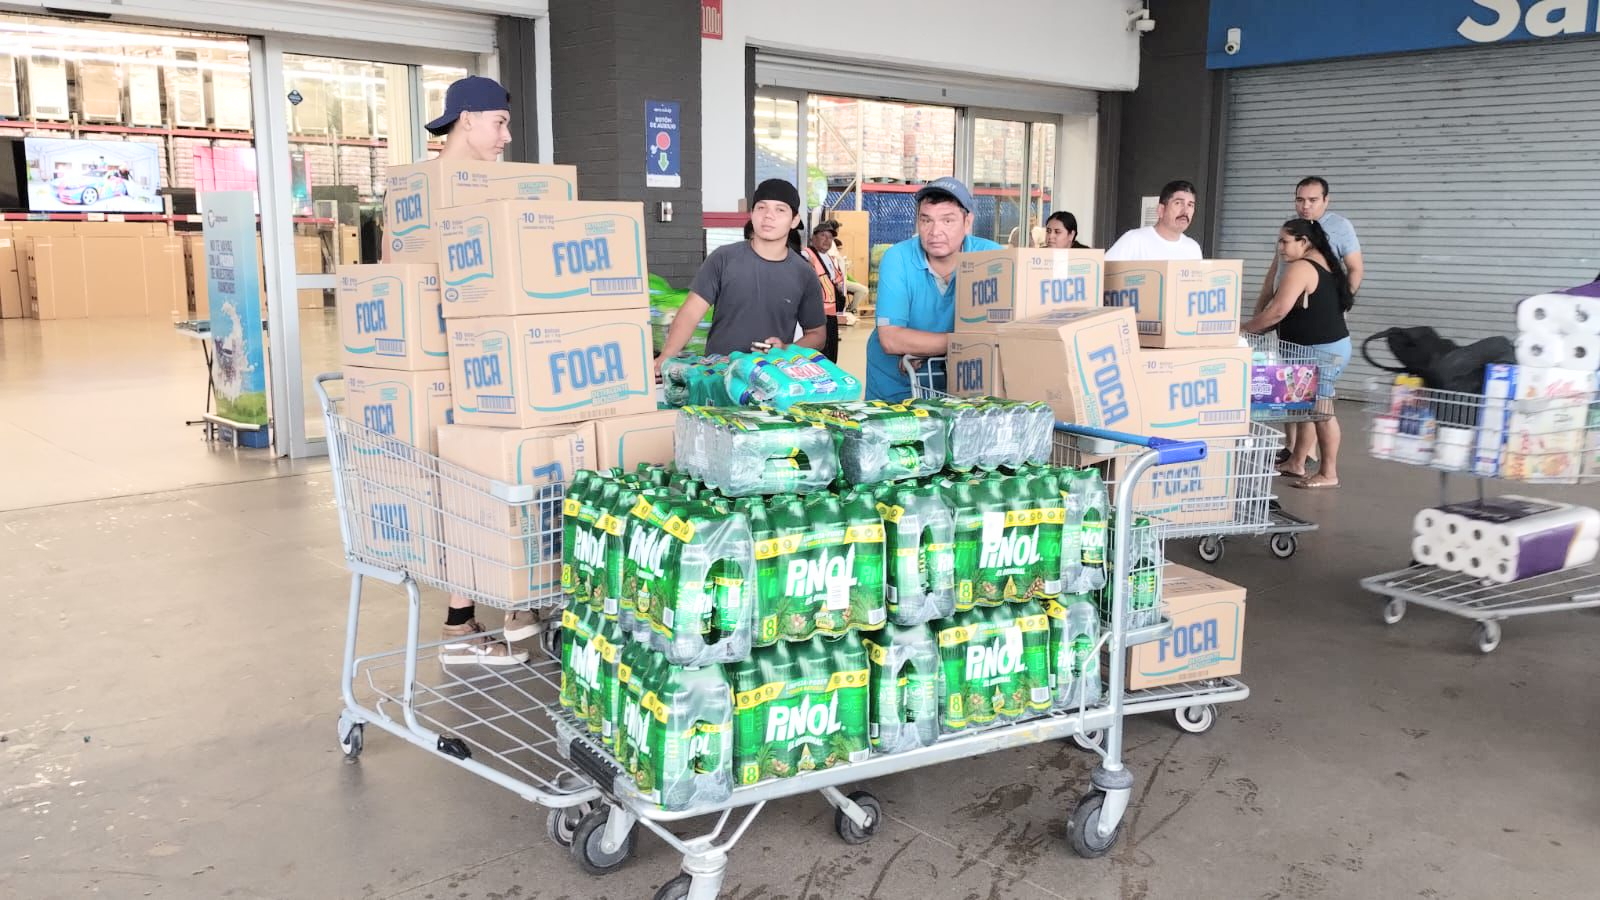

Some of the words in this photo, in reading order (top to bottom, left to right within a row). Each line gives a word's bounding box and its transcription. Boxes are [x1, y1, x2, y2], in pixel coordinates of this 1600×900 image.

[1457, 0, 1600, 42] Sa
[457, 171, 468, 181] 10
[395, 193, 422, 224] FOCA
[522, 212, 535, 223] 10
[447, 238, 483, 272] FOCA
[552, 237, 611, 277] FOCA
[1032, 257, 1041, 265] 10
[424, 276, 436, 286] 10
[972, 277, 998, 306] FOCA
[1040, 276, 1087, 305] FOCA
[355, 299, 387, 335] FOCA
[1187, 288, 1227, 316] FOCA
[528, 328, 541, 338] 10
[463, 354, 502, 389] FOCA
[549, 341, 626, 395] FOCA
[956, 358, 983, 392] FOCA
[432, 382, 445, 391] 10
[1087, 344, 1129, 426] FOCA
[1169, 377, 1219, 410] FOCA
[364, 403, 396, 437] FOCA
[1152, 465, 1203, 498] FOCA
[979, 524, 1041, 569] PINOL
[962, 583, 970, 600] 8
[766, 619, 774, 637] 8
[1158, 618, 1218, 663] FOCA
[765, 689, 842, 744] PINOL
[953, 697, 959, 711] 8
[746, 766, 756, 783] 8
